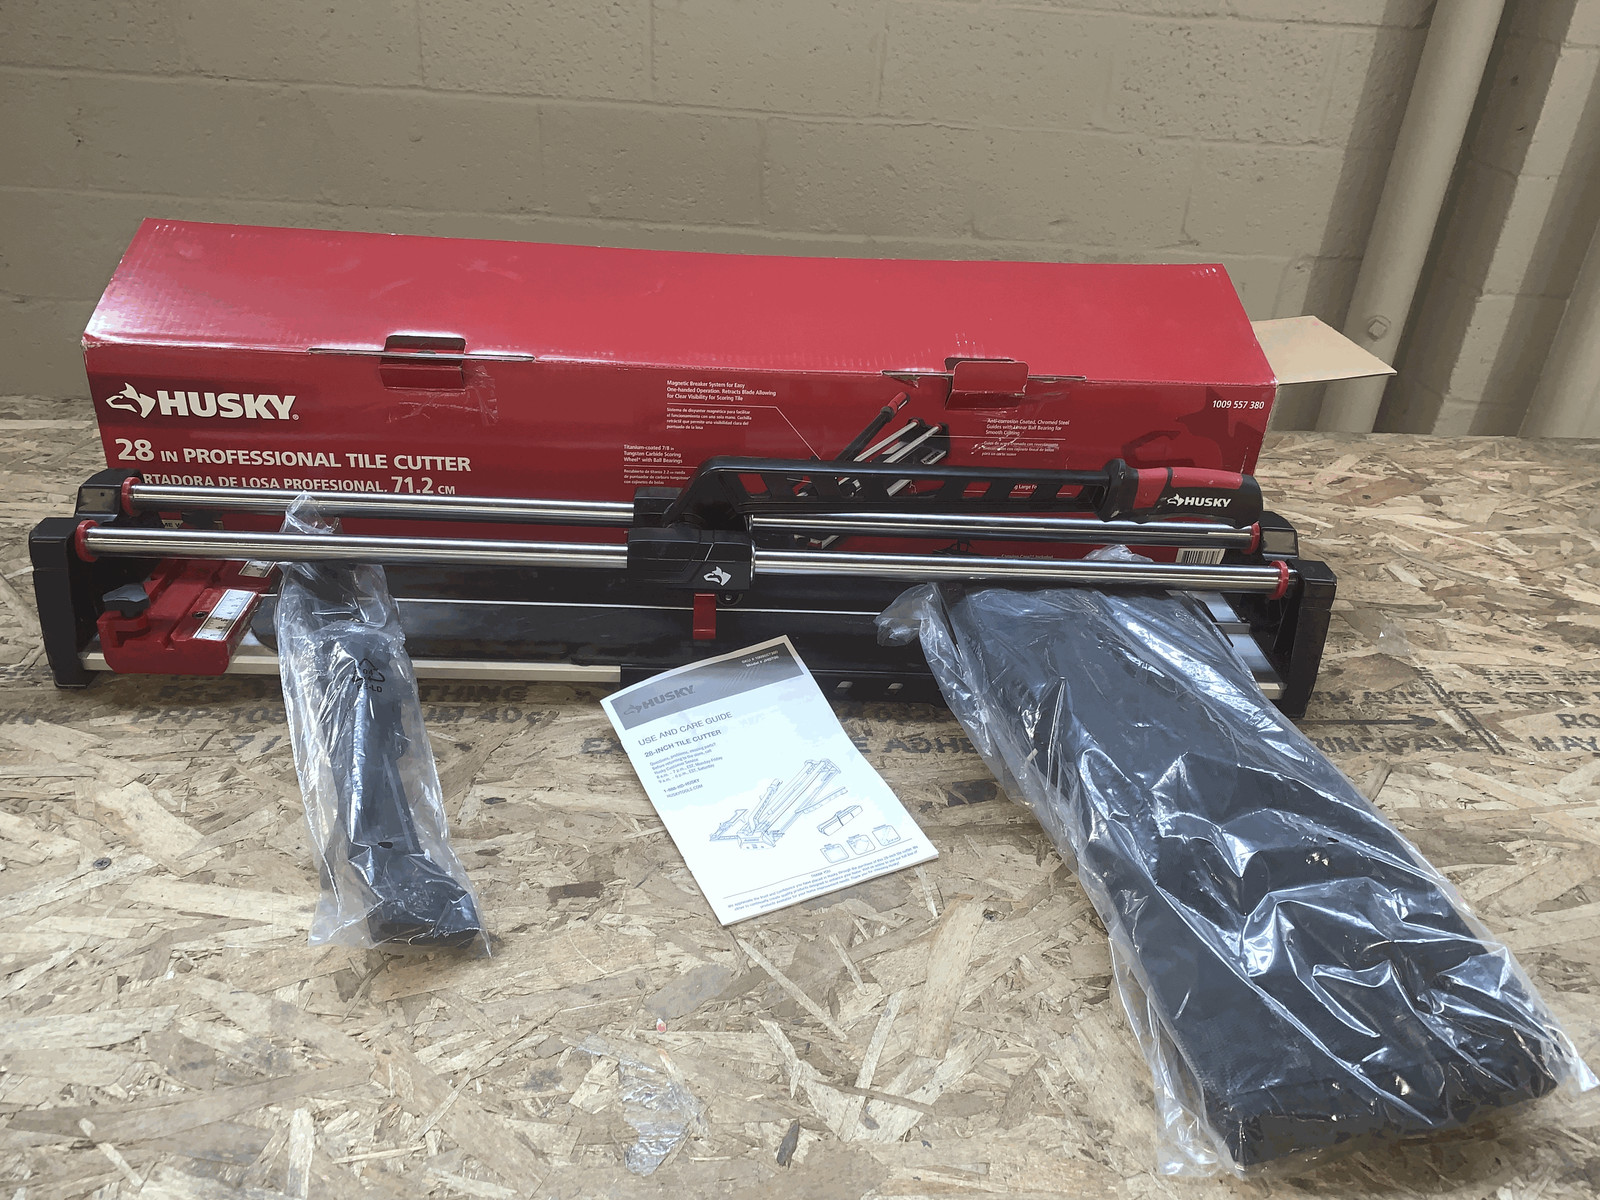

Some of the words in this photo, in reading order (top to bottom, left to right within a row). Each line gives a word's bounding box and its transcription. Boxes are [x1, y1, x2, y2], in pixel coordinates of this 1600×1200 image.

[156, 390, 296, 420] HUSKY
[1213, 400, 1231, 408] 1009
[115, 438, 154, 462] 28
[161, 450, 178, 462] IN
[183, 448, 342, 468] PROFESSIONAL
[345, 453, 388, 468] TILE
[394, 455, 472, 472] CUTTER
[143, 473, 213, 486] RTADORA
[218, 476, 237, 488] DE
[242, 477, 278, 490] LOSA
[391, 476, 434, 494] 71.2
[438, 485, 456, 494] CM
[1184, 497, 1231, 508] HUSKY
[642, 685, 694, 710] HUSKY
[638, 734, 658, 746] USE
[660, 728, 678, 741] AND
[680, 720, 704, 734] CARE
[705, 712, 733, 727] GUIDE
[644, 743, 674, 758] 28-INCH
[675, 737, 692, 748] TILE
[692, 729, 722, 743] CUTTER
